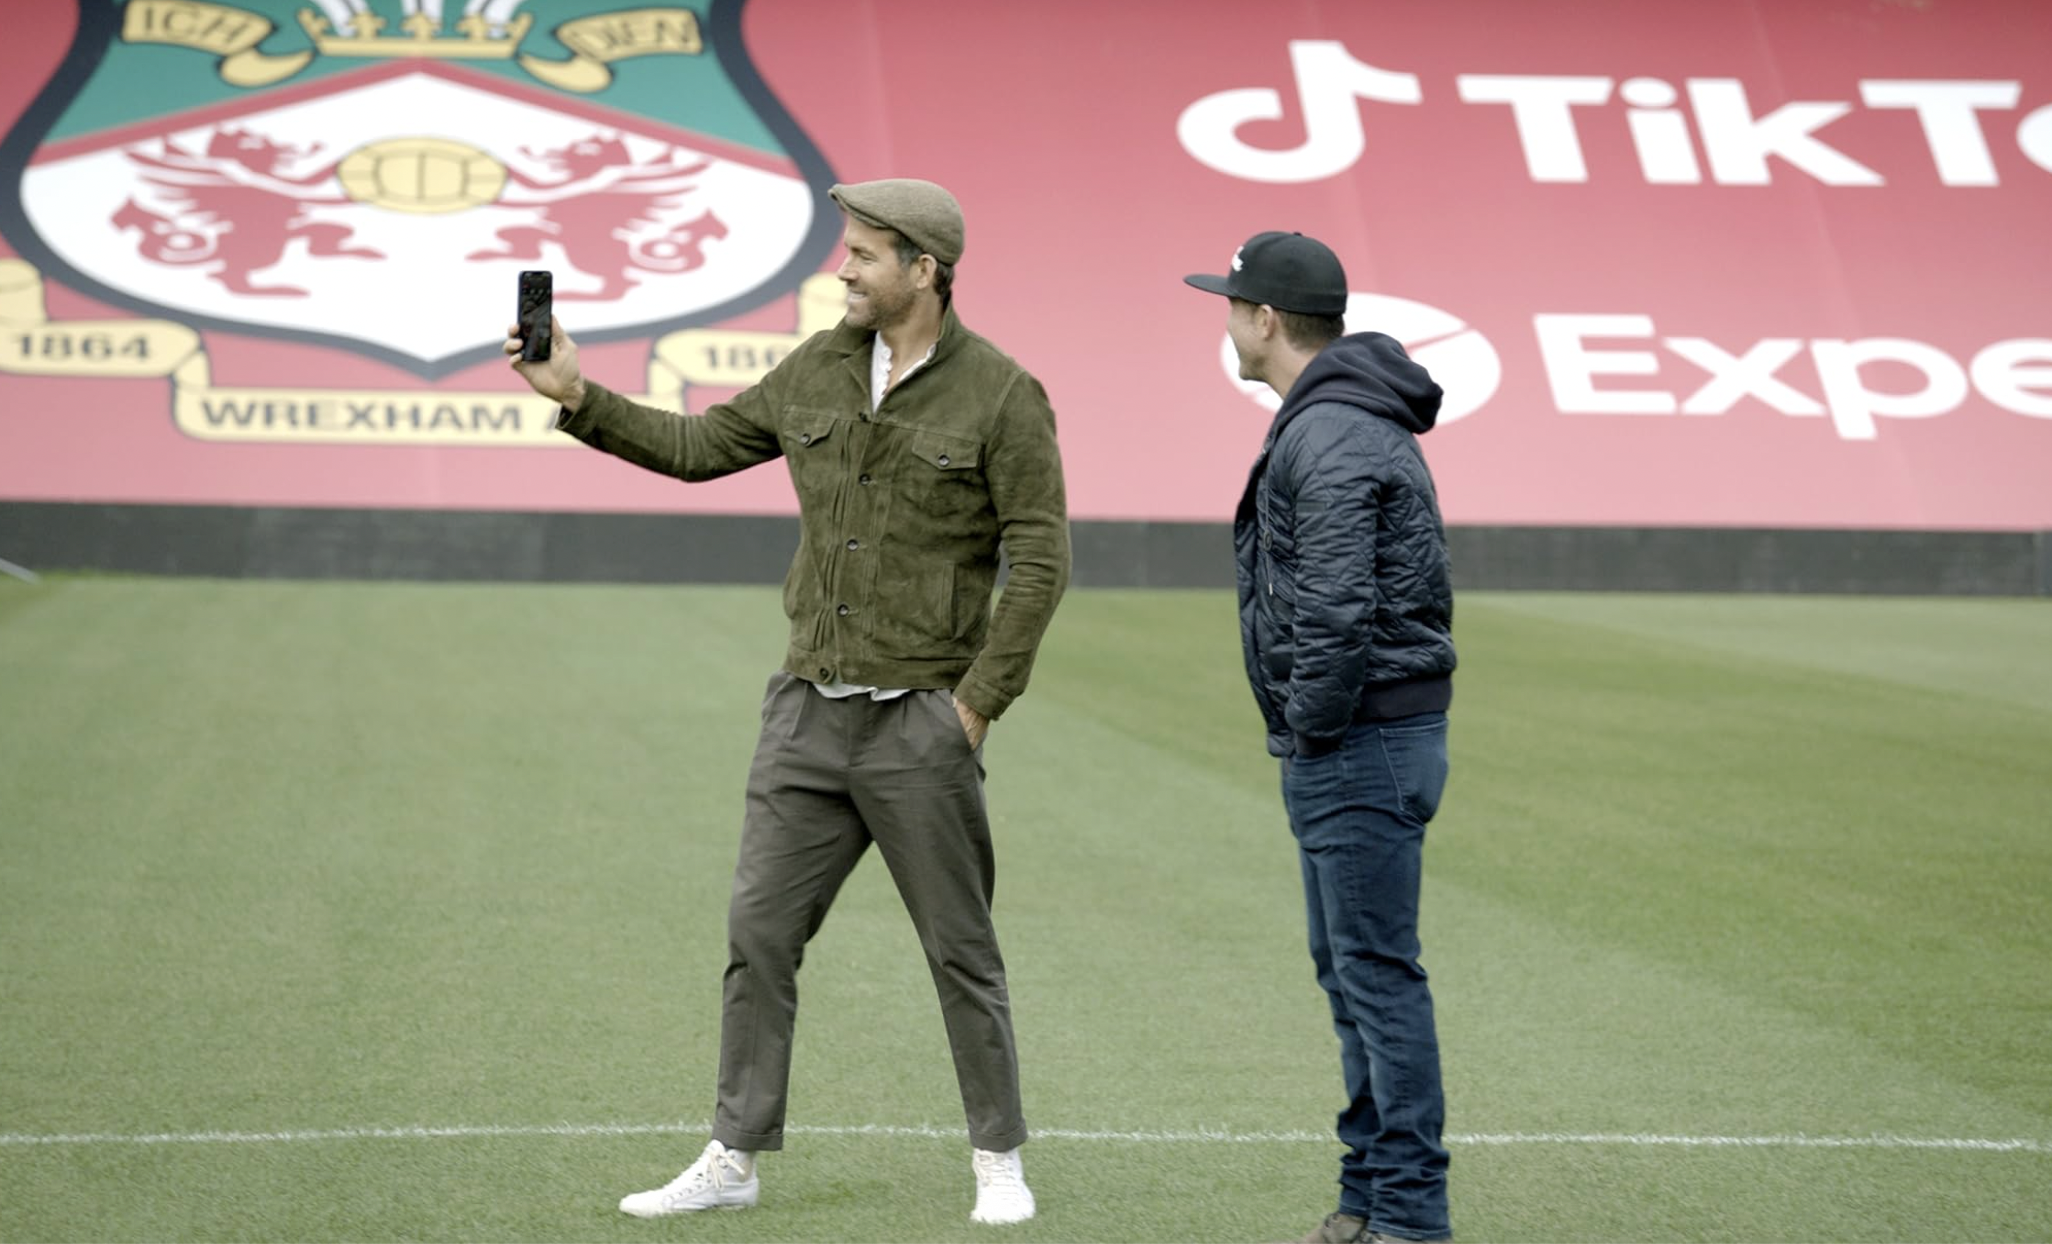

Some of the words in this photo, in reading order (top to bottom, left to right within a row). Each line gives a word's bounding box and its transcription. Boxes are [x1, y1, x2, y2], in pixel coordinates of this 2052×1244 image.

[1456, 73, 2052, 188] TikT
[10, 331, 153, 362] 1864
[1532, 313, 2052, 441] Expe
[201, 398, 521, 433] WREXHAM
